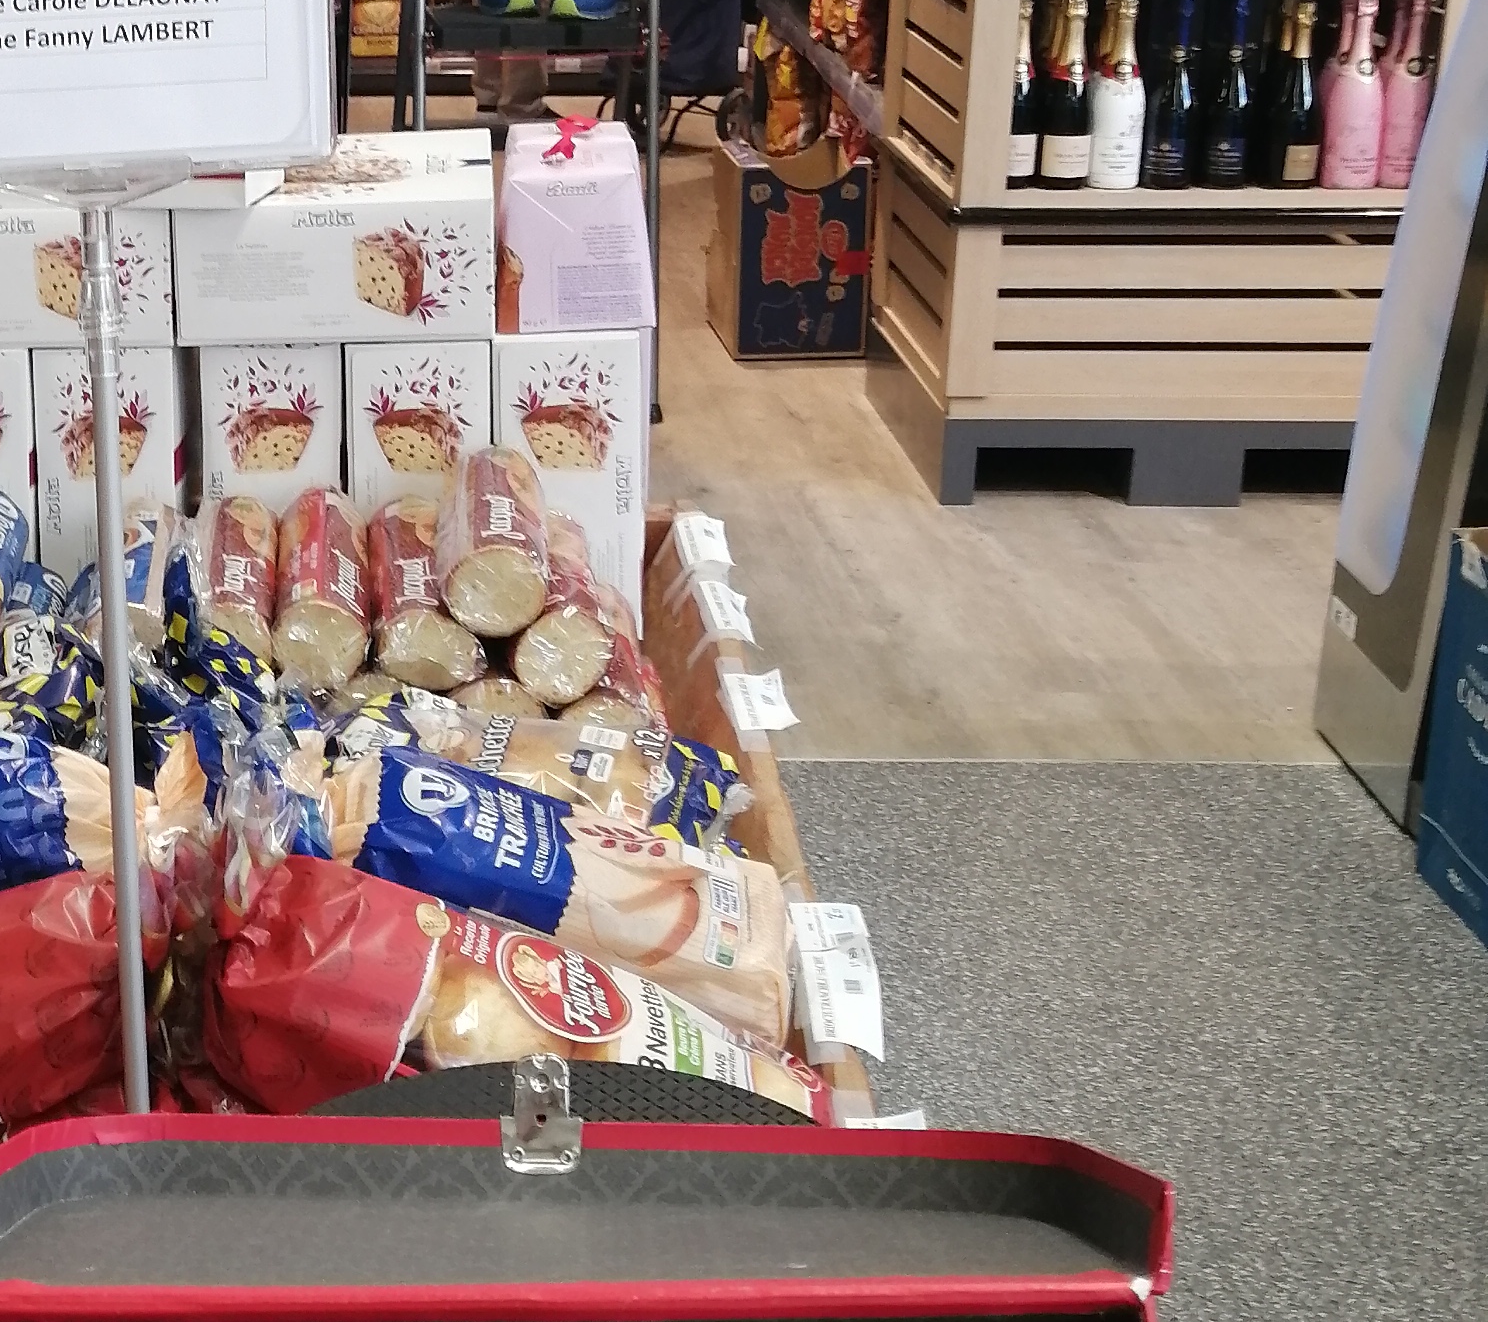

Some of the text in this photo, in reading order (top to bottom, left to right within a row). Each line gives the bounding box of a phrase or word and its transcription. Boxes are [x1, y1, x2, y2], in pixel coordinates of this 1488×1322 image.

[24, 24, 95, 52] Fanny
[102, 17, 215, 45] LAMBERT
[644, 978, 670, 1058] Navettes
